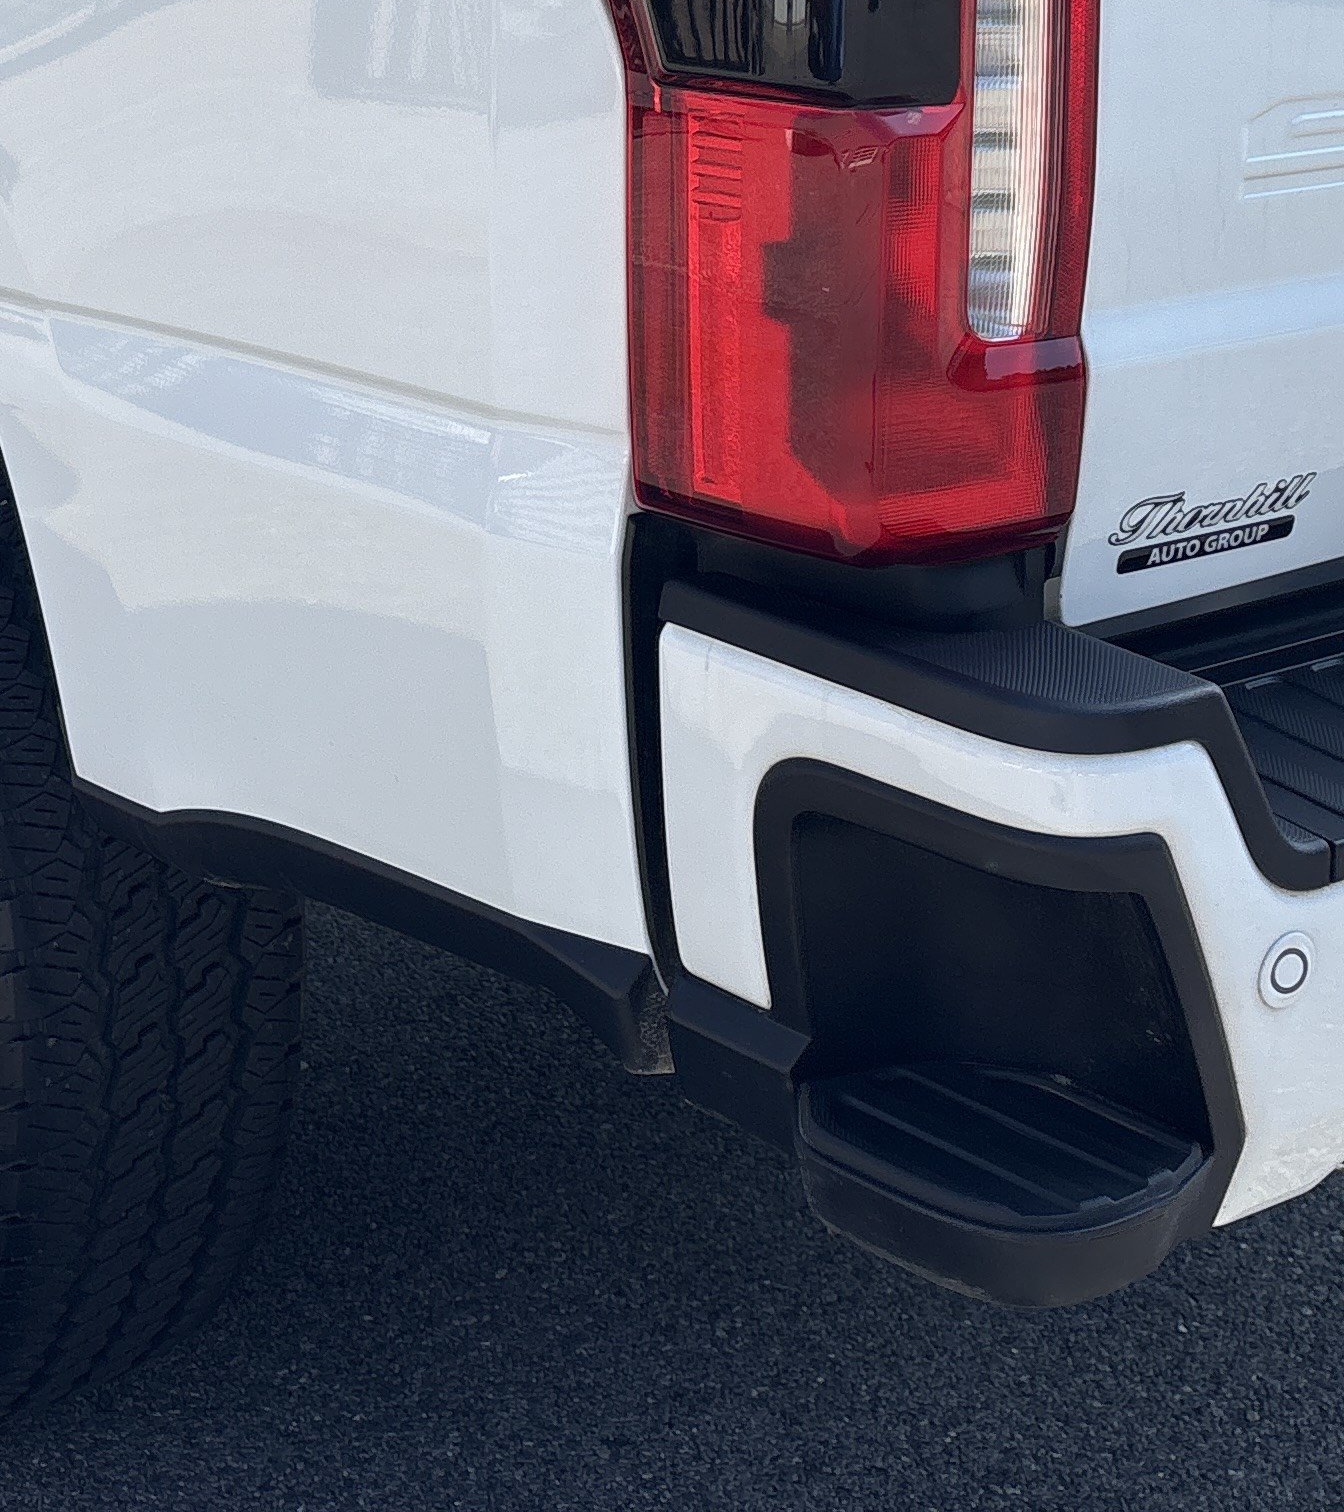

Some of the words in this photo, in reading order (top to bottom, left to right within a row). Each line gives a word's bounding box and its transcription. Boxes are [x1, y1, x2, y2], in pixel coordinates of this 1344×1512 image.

[1107, 471, 1317, 546] Thornhill
[1146, 541, 1201, 567] AUTO
[1203, 523, 1270, 552] GROUP
